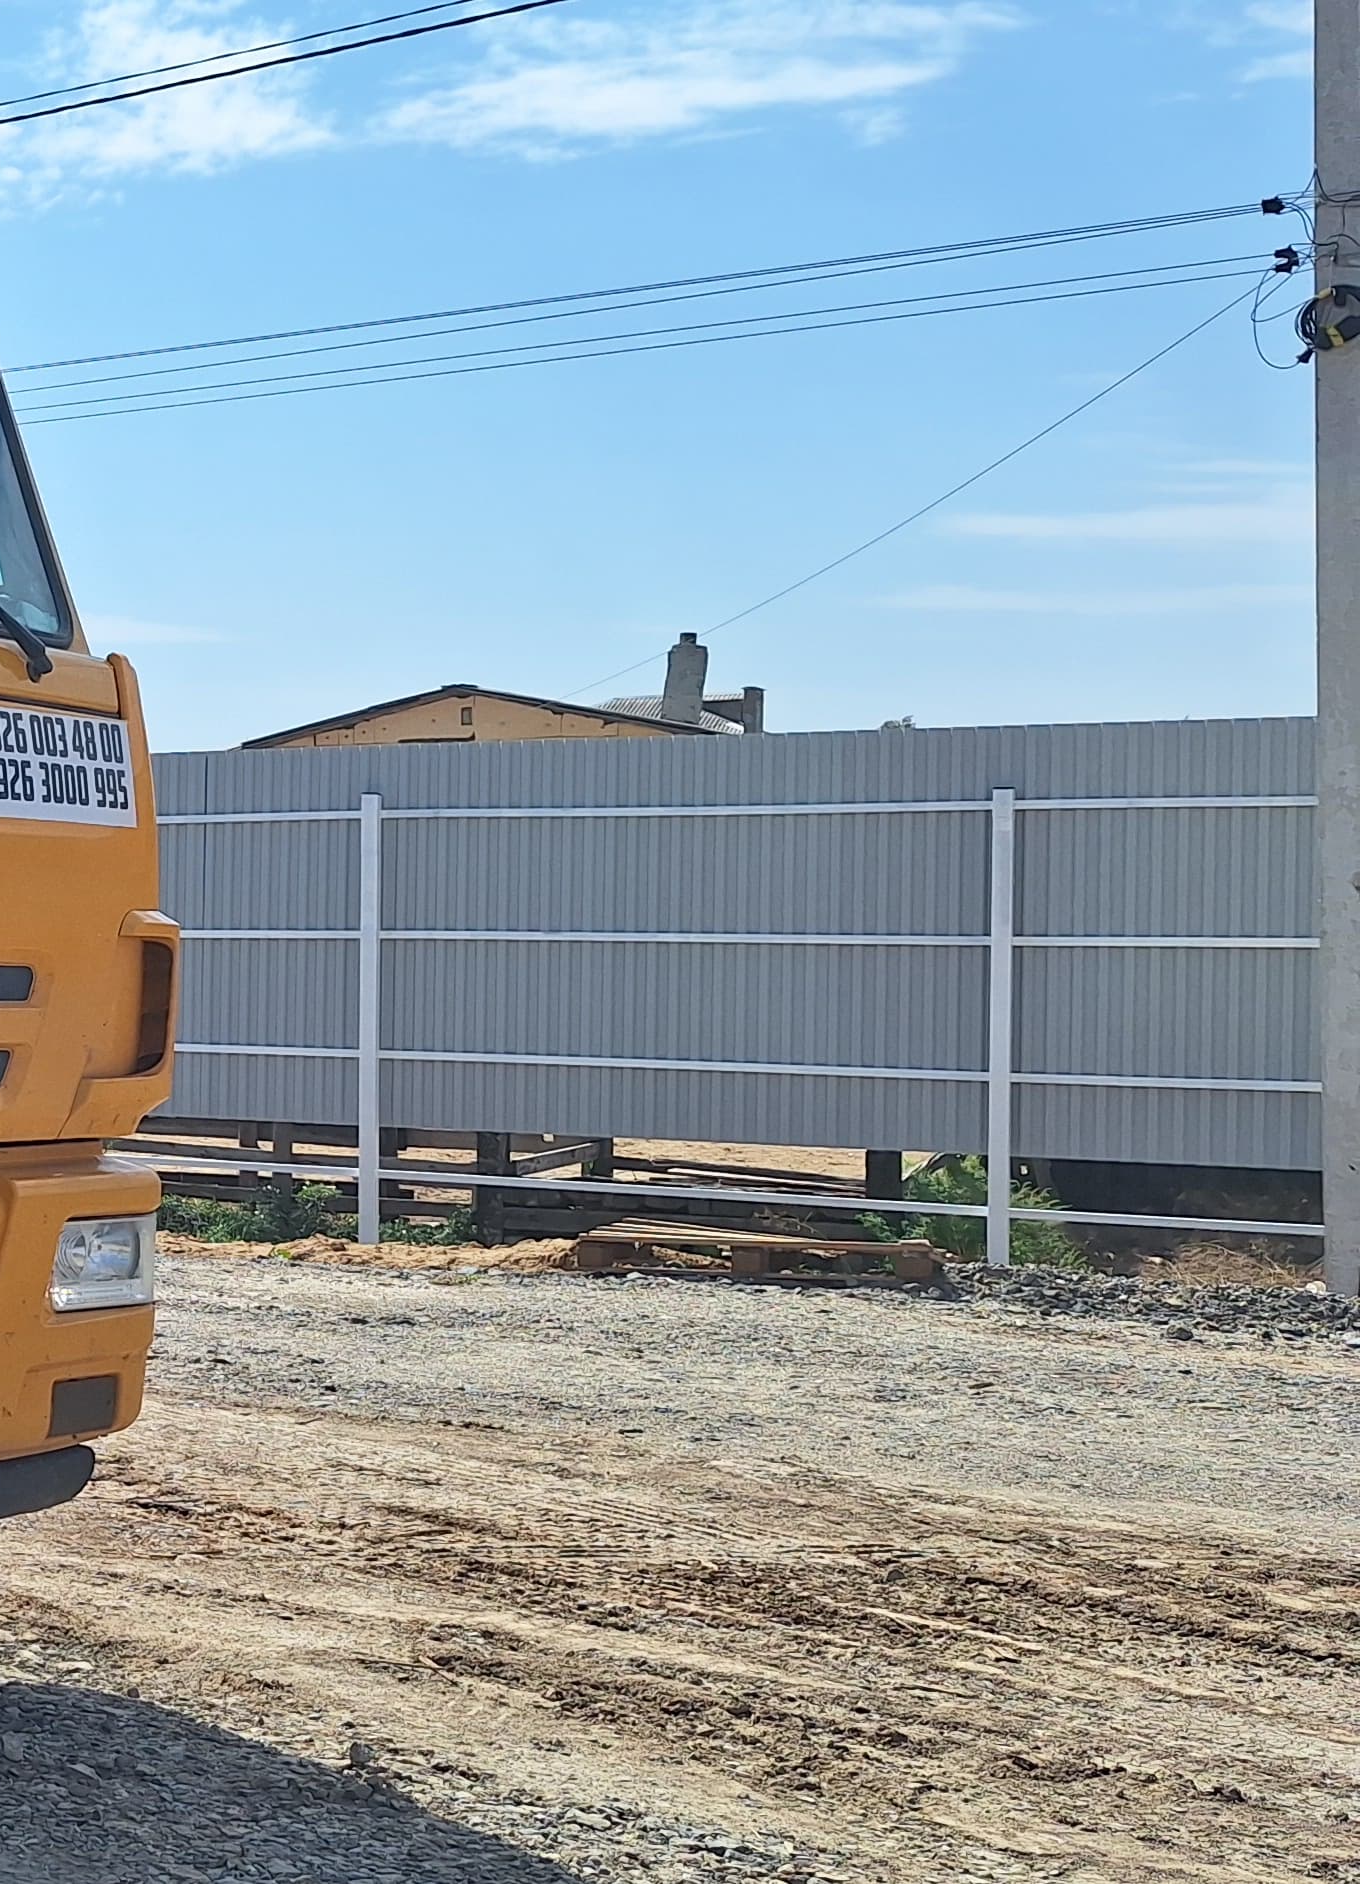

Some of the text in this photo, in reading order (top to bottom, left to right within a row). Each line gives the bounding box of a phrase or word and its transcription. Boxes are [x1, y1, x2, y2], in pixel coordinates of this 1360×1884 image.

[30, 715, 68, 758] 003
[72, 720, 97, 761] 48
[99, 723, 123, 763] 00
[39, 762, 89, 806] 3000
[94, 768, 128, 809] 995
